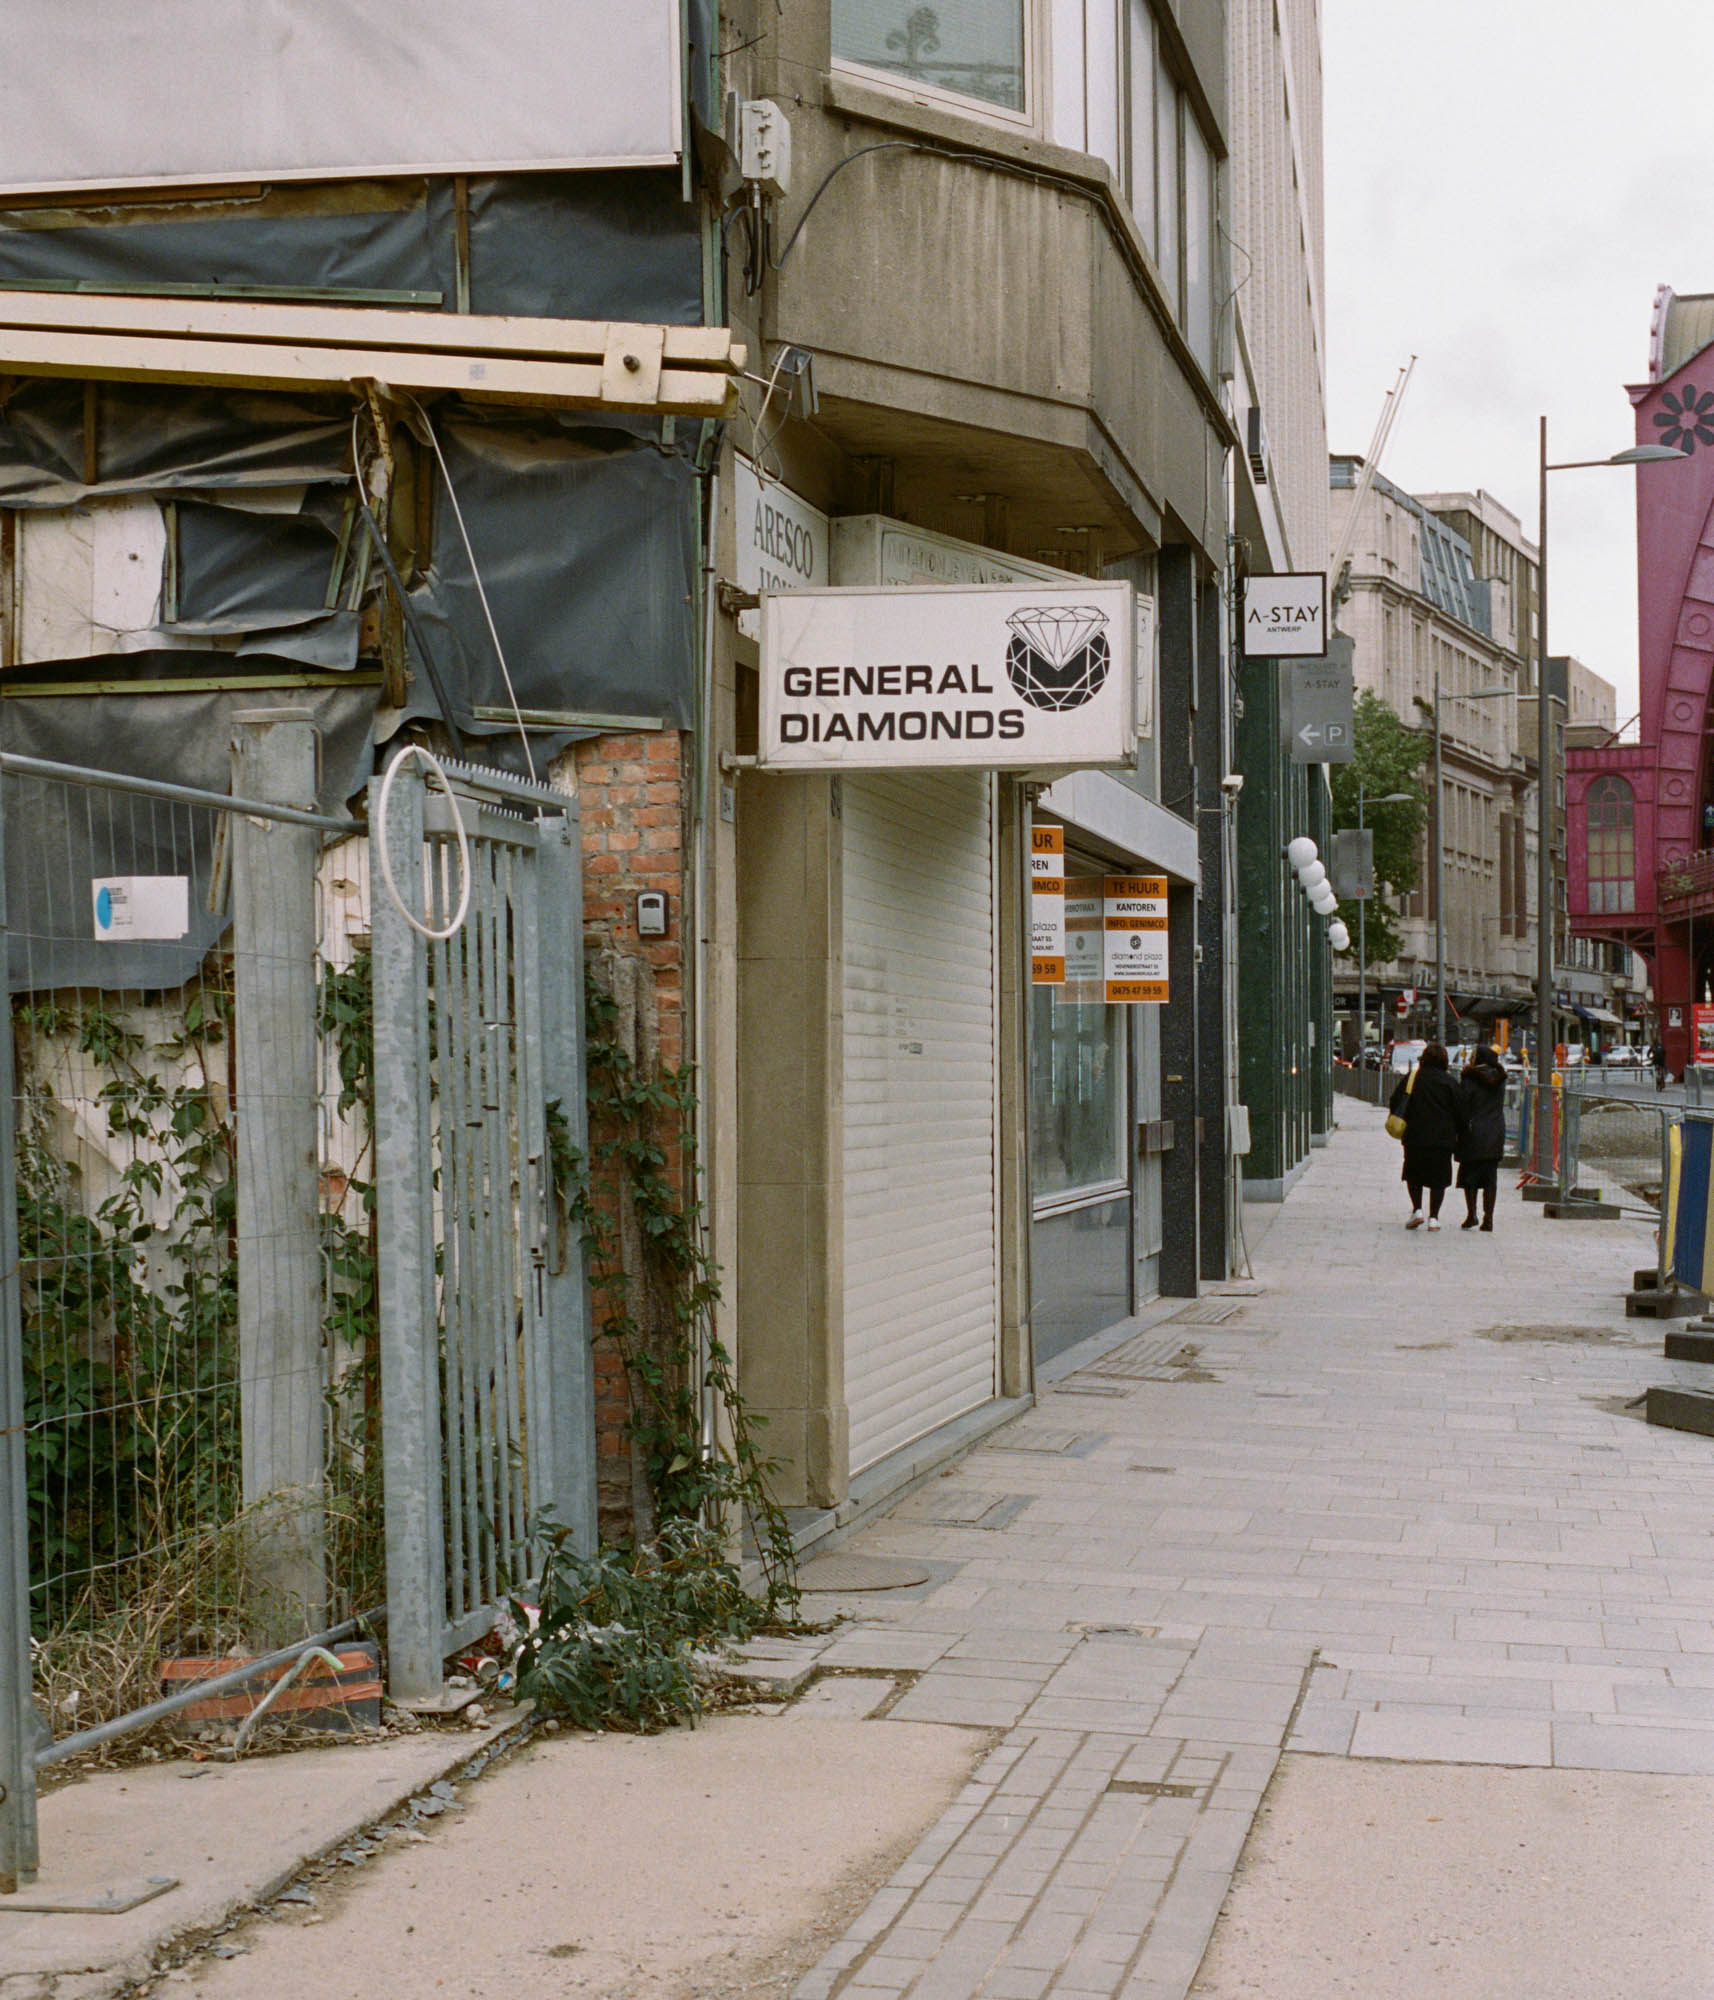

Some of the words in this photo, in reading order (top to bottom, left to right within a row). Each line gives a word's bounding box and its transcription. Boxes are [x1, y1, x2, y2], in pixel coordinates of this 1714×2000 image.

[753, 498, 813, 579] ARESCO
[784, 664, 993, 697] GENERAL
[780, 709, 1025, 743] DIAMONDS
[1328, 726, 1343, 742] P
[1033, 833, 1053, 848] UR
[1113, 882, 1124, 894] TE
[1128, 882, 1160, 894] HUUR
[1116, 903, 1156, 912] KANTOREN
[1032, 921, 1057, 932] plaza
[1129, 920, 1164, 929] GENIMCO
[1144, 952, 1163, 961] plaza
[1112, 986, 1130, 995] 0475
[1132, 986, 1141, 995] 47
